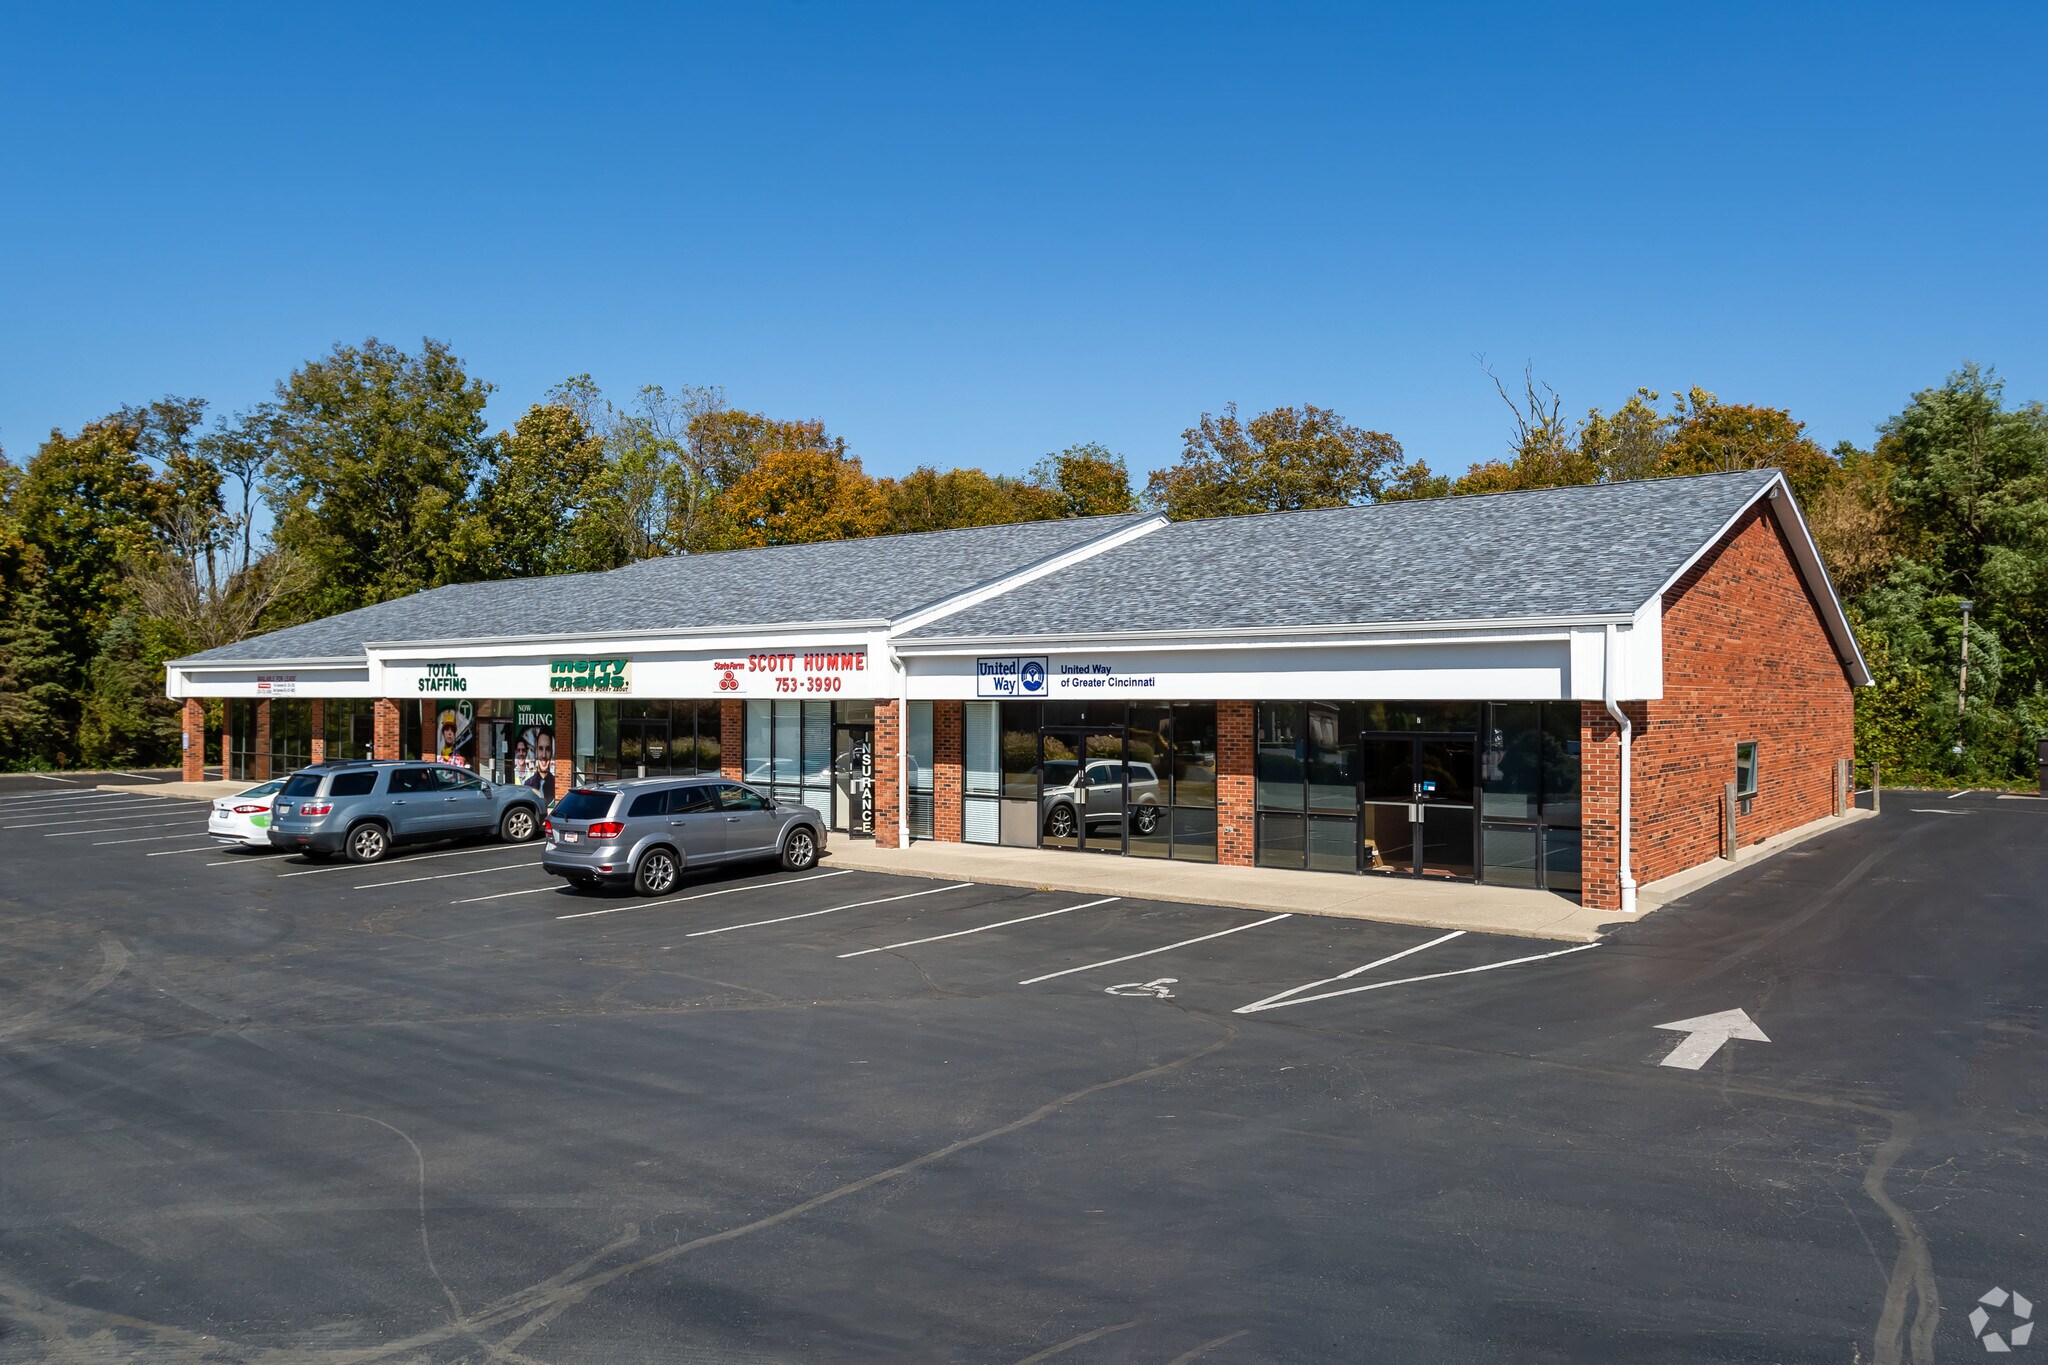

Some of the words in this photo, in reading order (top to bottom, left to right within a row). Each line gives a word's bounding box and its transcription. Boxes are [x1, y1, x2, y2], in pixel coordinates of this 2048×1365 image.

[427, 663, 458, 677] TOTAL
[551, 659, 628, 675] merry
[748, 653, 796, 672] SCOTT
[979, 661, 1016, 676] United
[1061, 665, 1090, 675] United
[1092, 664, 1112, 676] Way
[418, 678, 467, 692] STAFFING
[775, 676, 842, 692] 753-3990
[993, 677, 1016, 694] Way
[1061, 678, 1070, 687] of
[1072, 678, 1105, 687] Greater
[1108, 677, 1155, 687] Cincinnati
[518, 713, 553, 726] HIRING
[862, 731, 872, 833] INSURANCE
